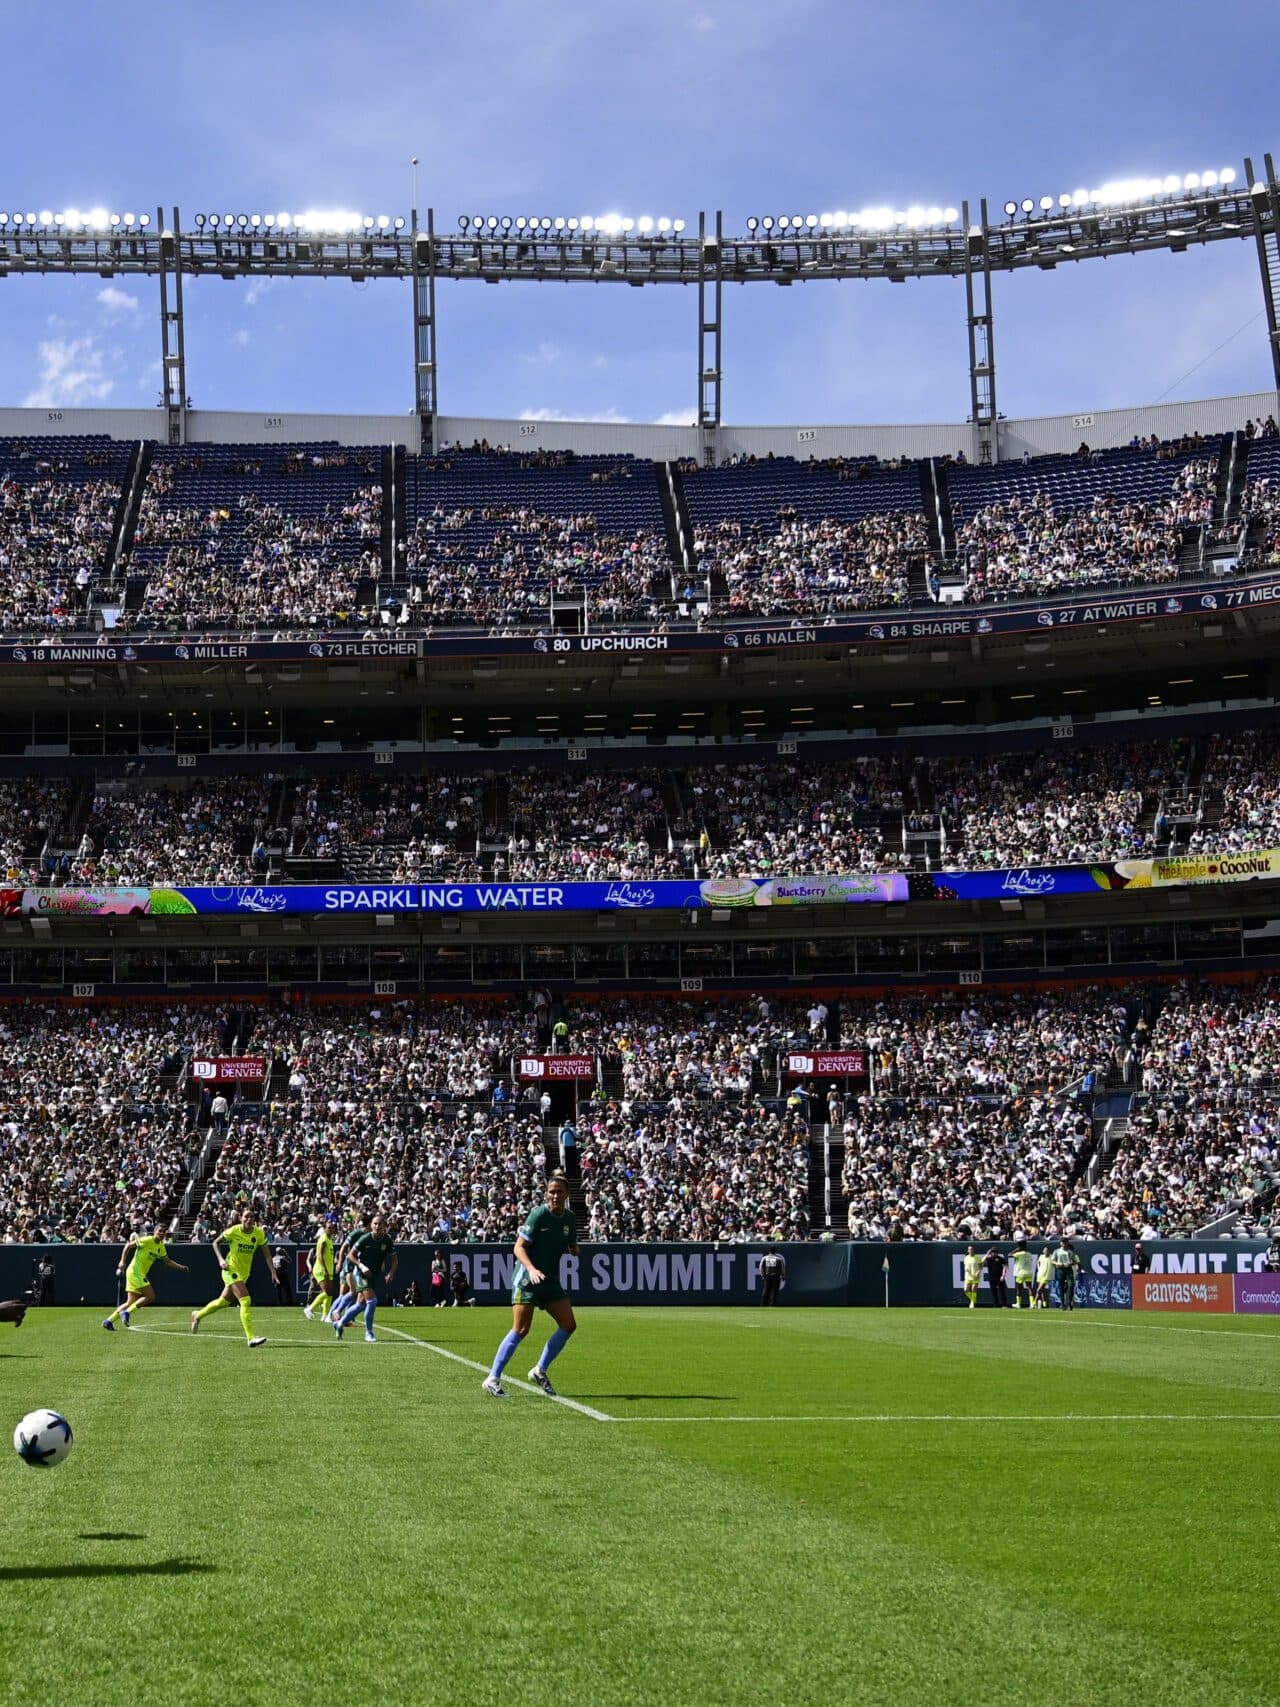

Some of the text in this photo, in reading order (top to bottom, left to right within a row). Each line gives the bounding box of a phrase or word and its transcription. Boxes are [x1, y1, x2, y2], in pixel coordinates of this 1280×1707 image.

[48, 412, 62, 421] 510
[1075, 417, 1092, 426] 514
[267, 418, 282, 426] 511
[520, 425, 536, 435] 512
[799, 431, 815, 440] 513
[1059, 611, 1076, 623] 27
[890, 626, 907, 637] 84
[912, 622, 971, 636] SHARPE
[744, 631, 816, 646] 66 NALEN
[553, 637, 668, 651] 80 UPCHURCH
[32, 649, 45, 660] 18
[50, 648, 117, 661] MANNING
[194, 646, 248, 658] MILLER
[327, 643, 417, 656] 73 FLETCHER
[1053, 727, 1073, 737] 316
[777, 743, 796, 753] 315
[375, 753, 393, 762] 313
[568, 750, 586, 759] 314
[178, 755, 195, 765] 312
[325, 887, 563, 908] SPARKLING WATER
[961, 972, 980, 983] 110
[75, 985, 93, 995] 107
[376, 983, 394, 993] 108
[682, 980, 701, 990] 109
[548, 1065, 592, 1075] DENVER
[818, 1062, 863, 1072] DENVER
[221, 1068, 263, 1078] DENVER
[592, 1253, 736, 1292] SUMMIT
[1145, 1282, 1192, 1303] canvas
